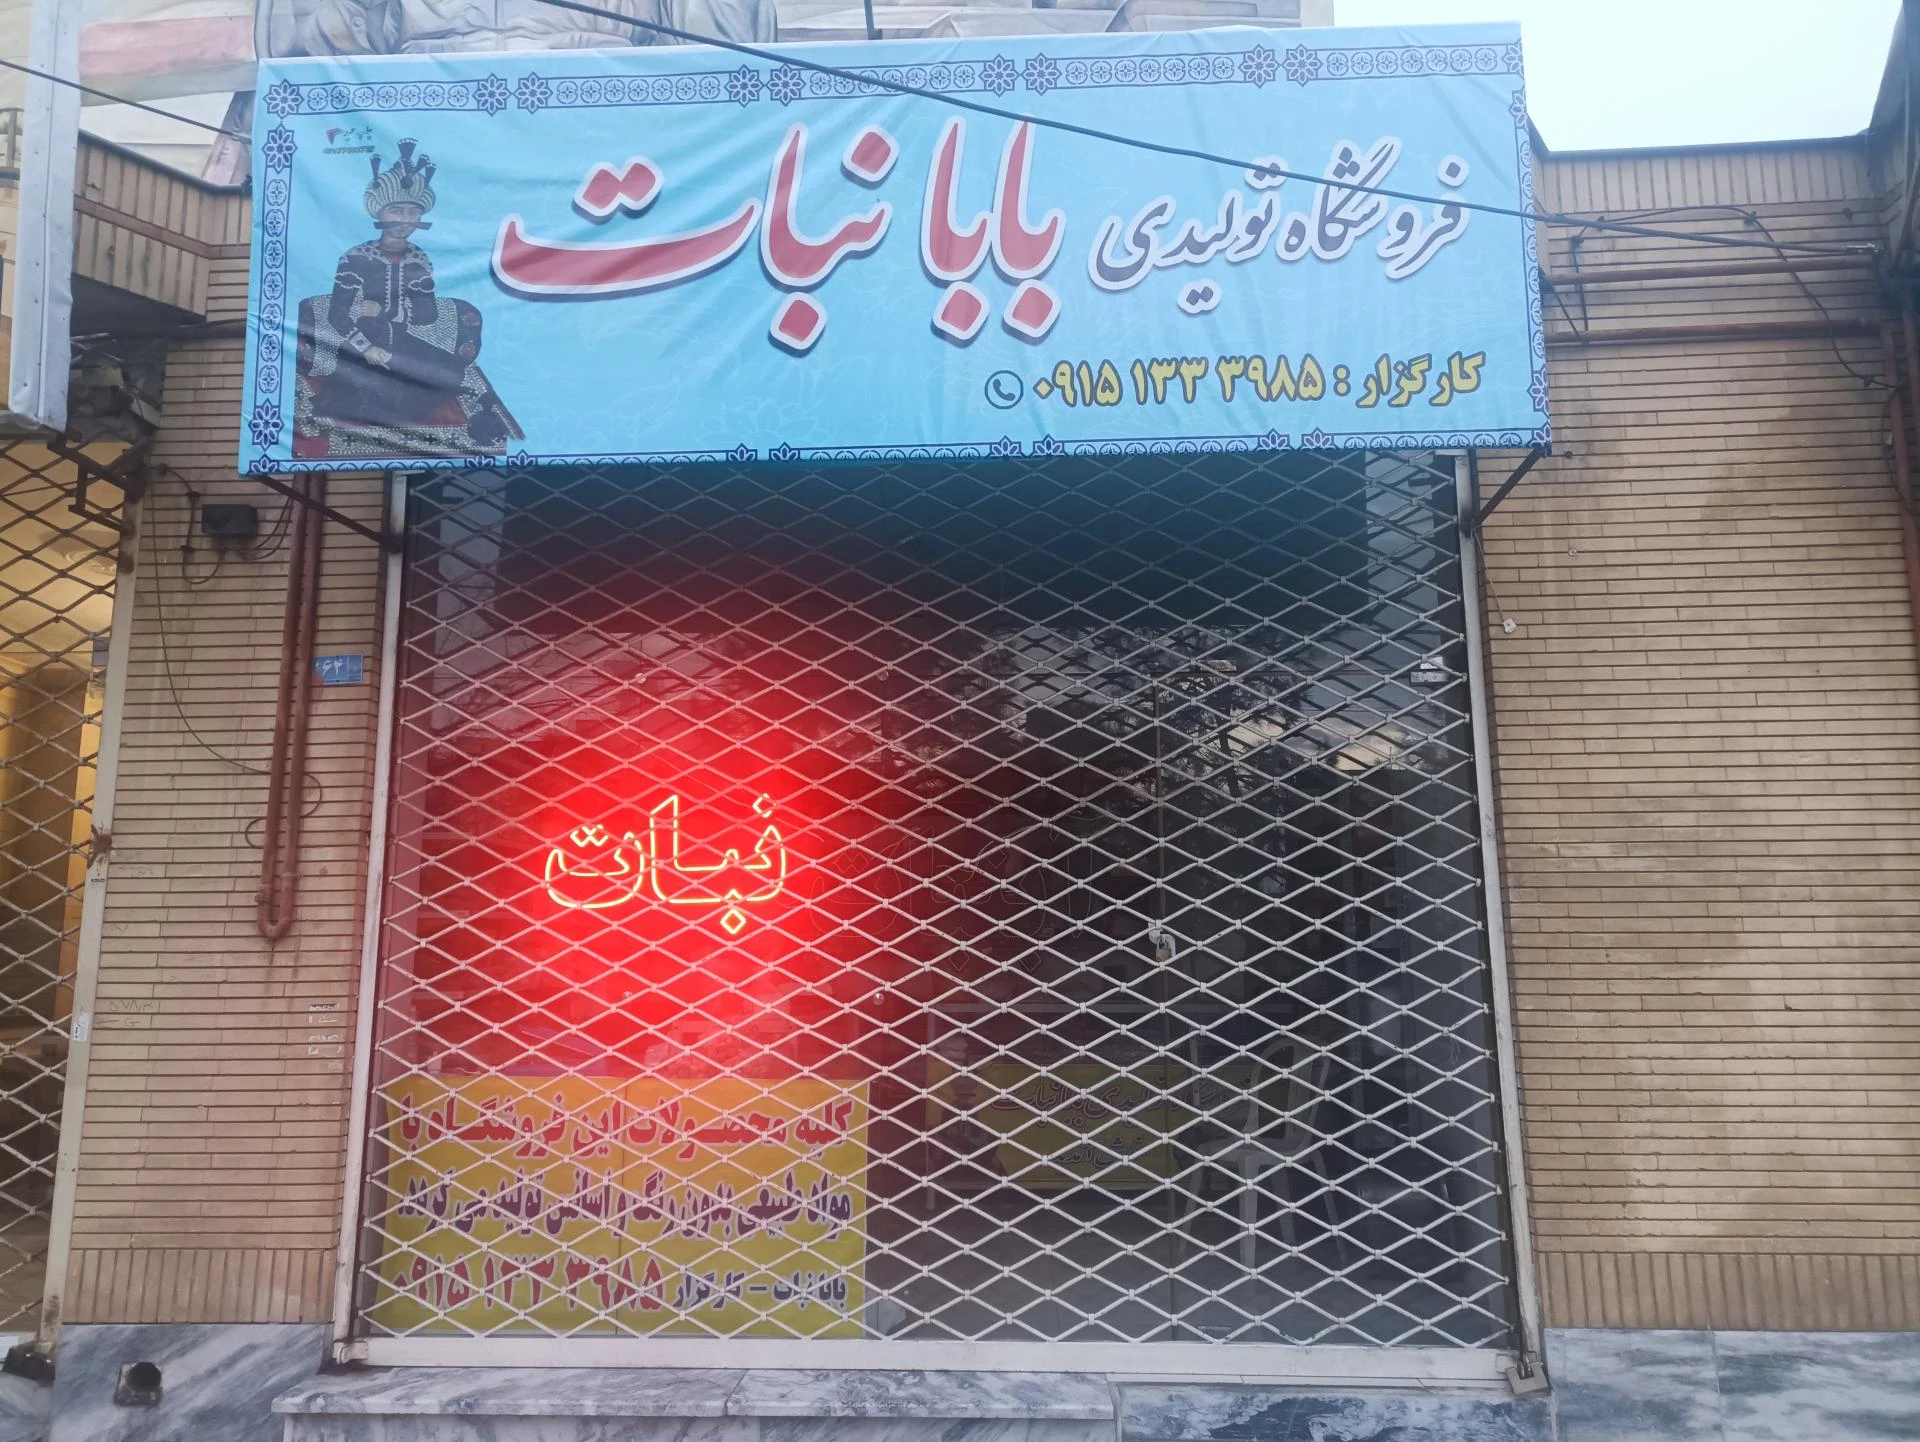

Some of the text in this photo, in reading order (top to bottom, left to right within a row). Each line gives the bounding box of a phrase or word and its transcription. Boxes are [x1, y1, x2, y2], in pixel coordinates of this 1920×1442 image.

[492, 114, 1469, 354] فروشگاه تولیدی بابا نبات
[1032, 358, 1122, 407] ۰۹۱۵
[1131, 358, 1206, 405] ۱۳۳
[1219, 355, 1324, 404] ۳۹۸۵
[545, 793, 786, 935] نبات
[400, 1092, 855, 1161] کلیه محصولات این فروشگاه با
[495, 1167, 544, 1235] تولید
[545, 1168, 612, 1235] اسانس
[612, 1190, 629, 1238] و
[632, 1169, 677, 1239] رنگ
[681, 1180, 733, 1238] بدون
[738, 1168, 804, 1239] طبیعی
[806, 1172, 852, 1240] مواد
[392, 1253, 471, 1309] ۰۹۱۵
[484, 1253, 557, 1310] ۱۳۳
[564, 1253, 665, 1311] ۳۹۸۵
[672, 1270, 747, 1311] کارگزار
